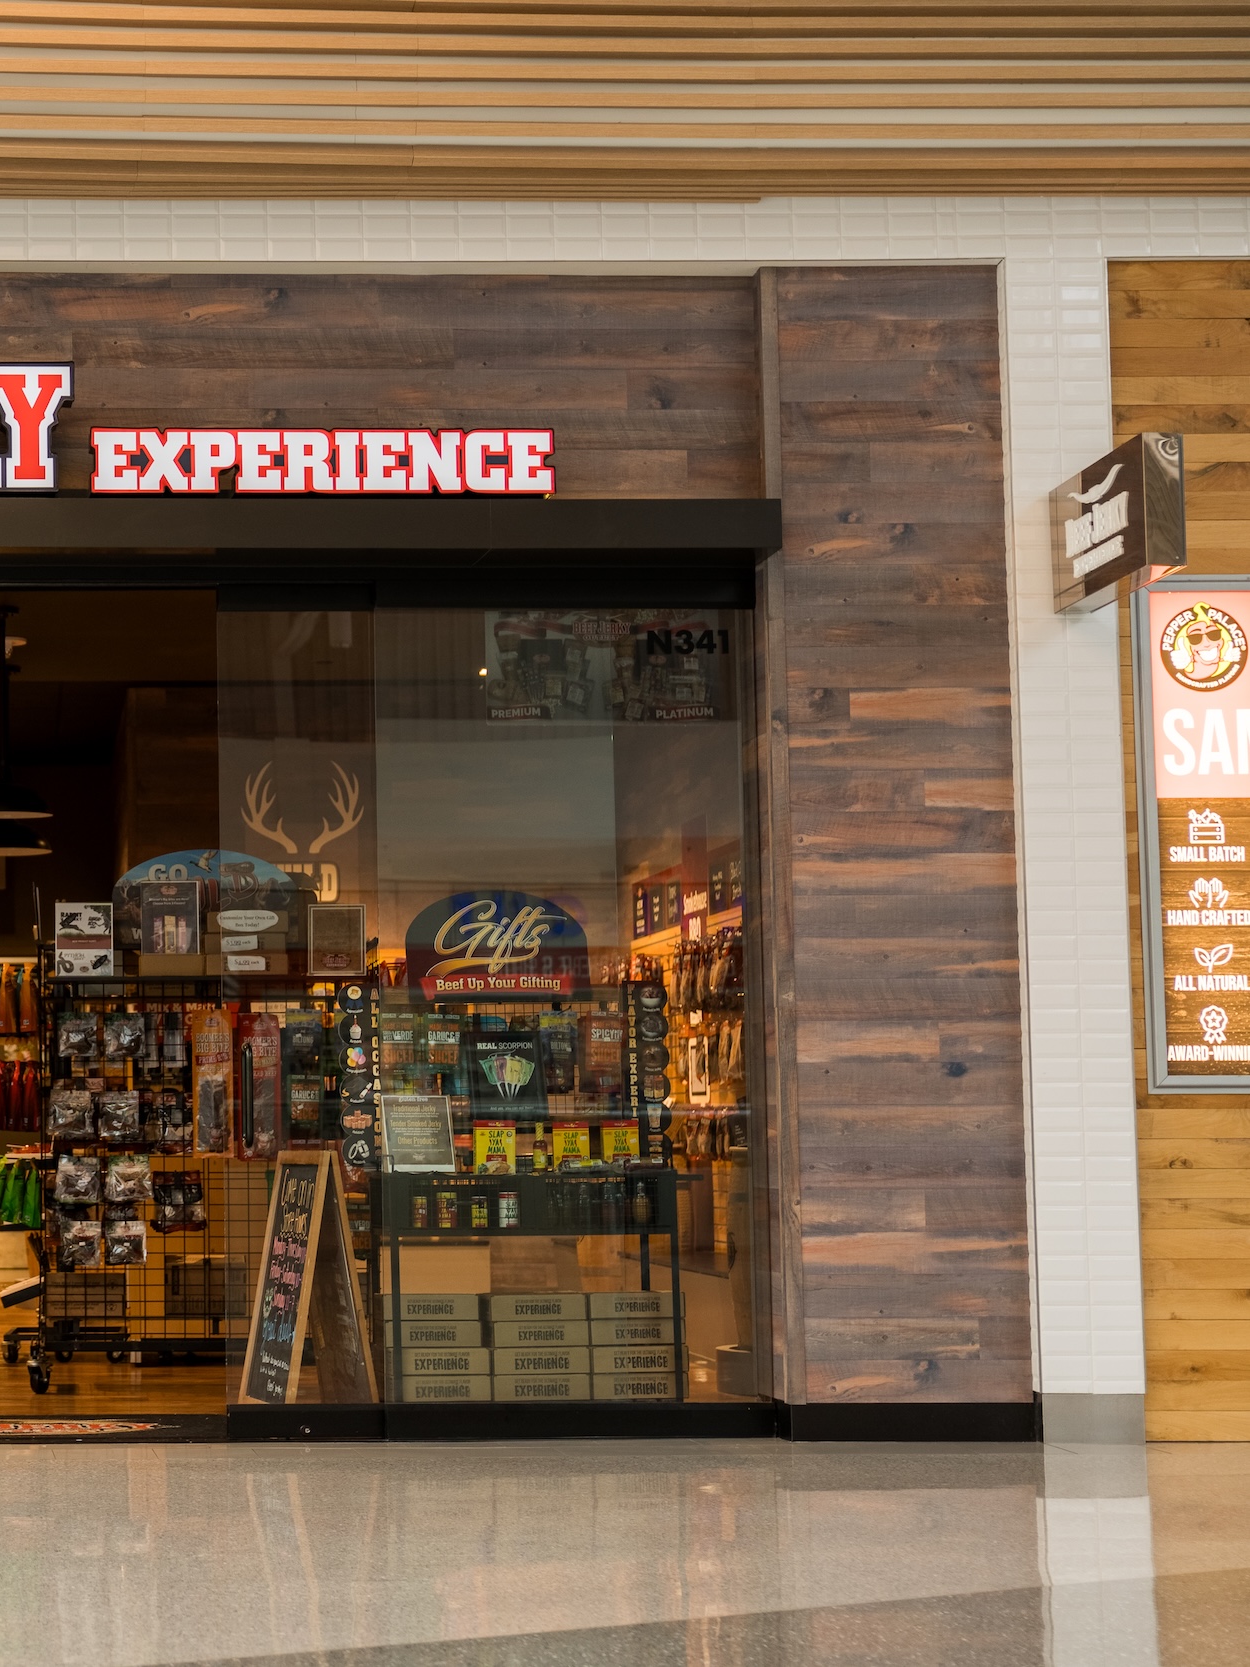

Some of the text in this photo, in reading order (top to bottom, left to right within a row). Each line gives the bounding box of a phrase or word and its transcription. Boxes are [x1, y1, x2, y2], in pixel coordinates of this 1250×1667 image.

[91, 428, 555, 494] EXPERIENCE
[1162, 610, 1195, 651] PEPPER
[647, 629, 730, 654] N341
[491, 706, 541, 719] PREMIUM
[655, 706, 714, 719] PLATINUM
[1169, 846, 1246, 863] SMALL BATCH
[148, 863, 189, 881] GO
[1167, 910, 1250, 926] HAND CRAFTED
[432, 900, 560, 974] Gifts
[436, 976, 561, 991] Beef Up Your Gifting
[1174, 975, 1250, 991] ALL NATURAL
[146, 1003, 183, 1012] Mix &
[370, 988, 380, 1028] ALL
[627, 984, 637, 1049] FLAVOR
[196, 1033, 230, 1041] BOOMER'S
[393, 1030, 414, 1041] VERDE
[196, 1043, 230, 1053] BIG BITE
[477, 1041, 534, 1050] REAL SCORPION
[260, 1047, 277, 1057] BITE
[629, 1053, 639, 1121] EXPERI
[393, 1104, 436, 1114] Traditional Jerky
[390, 1120, 442, 1129] Tender Smoked Jerky
[397, 1136, 438, 1145] Other Products
[487, 1146, 506, 1154] MAMA
[407, 1304, 454, 1315] EXPERIENCE
[515, 1304, 561, 1315] EXPERIENCE
[614, 1302, 660, 1312] EXPERIENCE
[409, 1331, 456, 1341] EXPERIENCE
[518, 1330, 564, 1341] EXPERIENCE
[615, 1329, 661, 1339] EXPERIENCE
[415, 1358, 470, 1370] EXPERIENCE
[515, 1357, 570, 1369] EXPERIENCE
[614, 1356, 669, 1368] EXPERIENCE
[416, 1385, 470, 1398] EXPERIENCE
[515, 1384, 570, 1397] EXPERIENCE
[614, 1383, 669, 1395] EXPERIENCE
